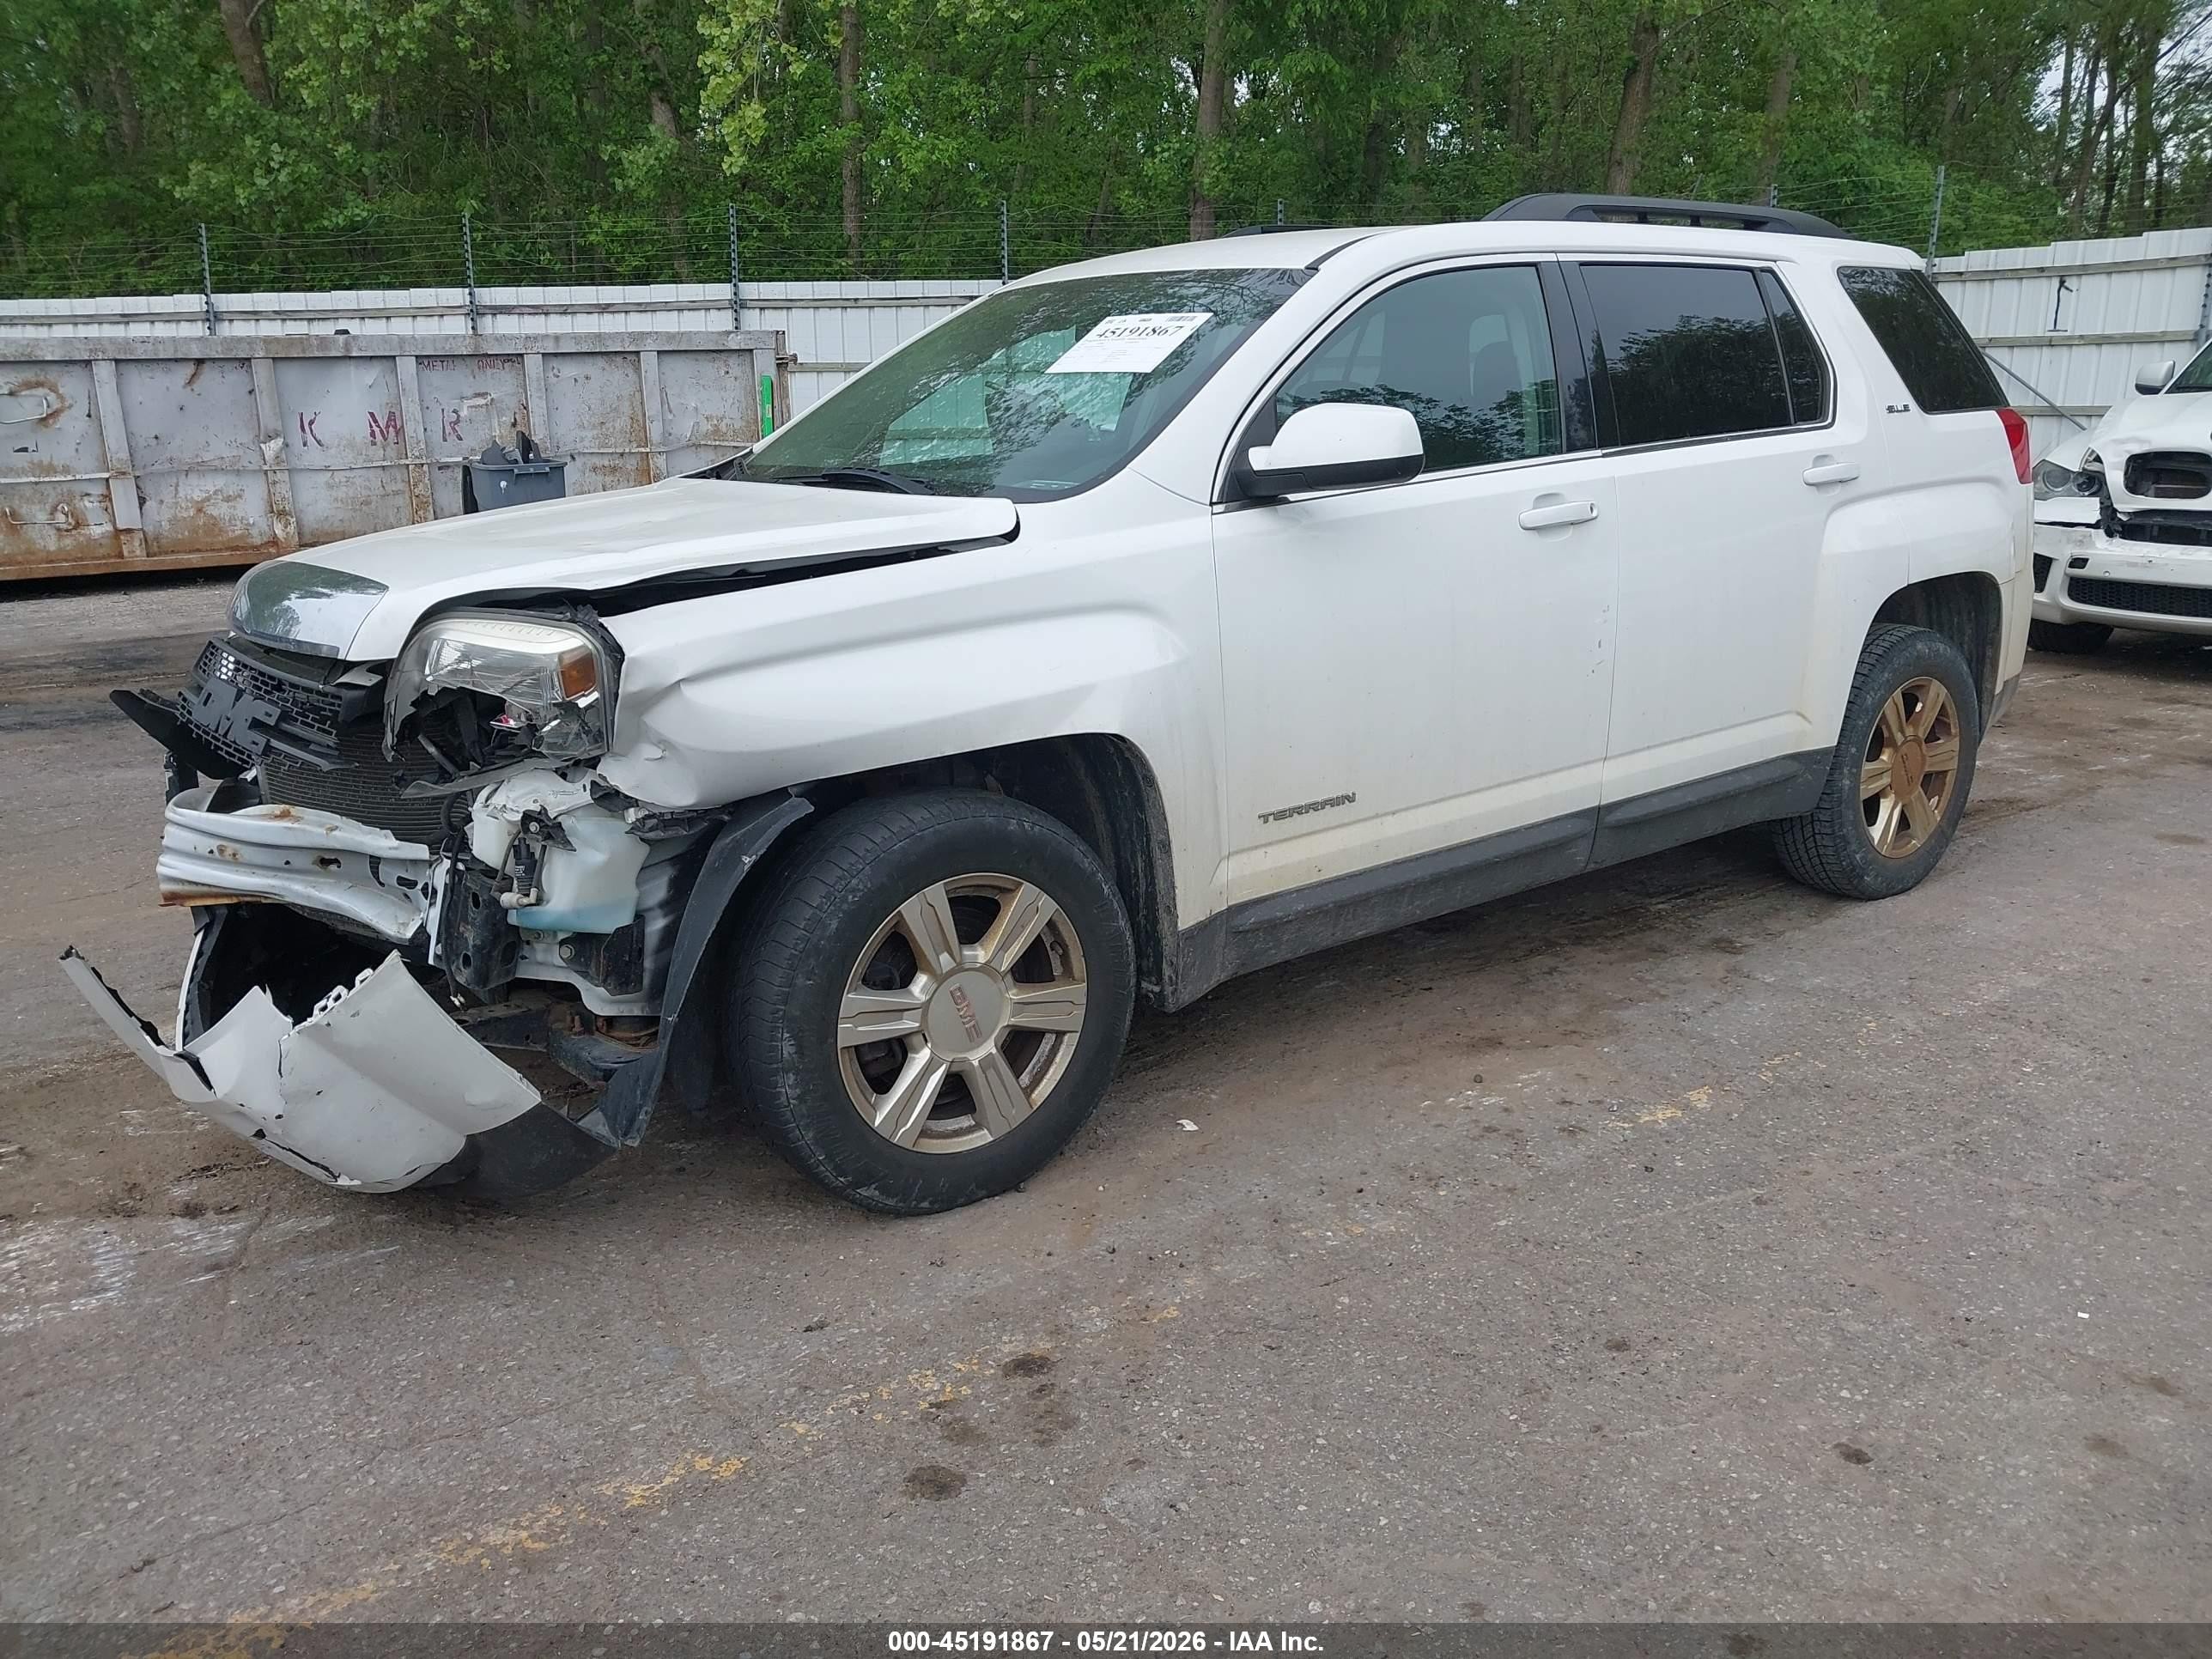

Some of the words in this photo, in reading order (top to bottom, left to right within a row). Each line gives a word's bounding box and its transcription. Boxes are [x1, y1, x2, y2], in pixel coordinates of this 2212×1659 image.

[1096, 325, 1185, 338] 45191867
[297, 410, 325, 447] K
[367, 410, 402, 447] M
[441, 408, 465, 443] R
[1257, 791, 1357, 824] TERRAIN
[948, 982, 983, 1043] GMC
